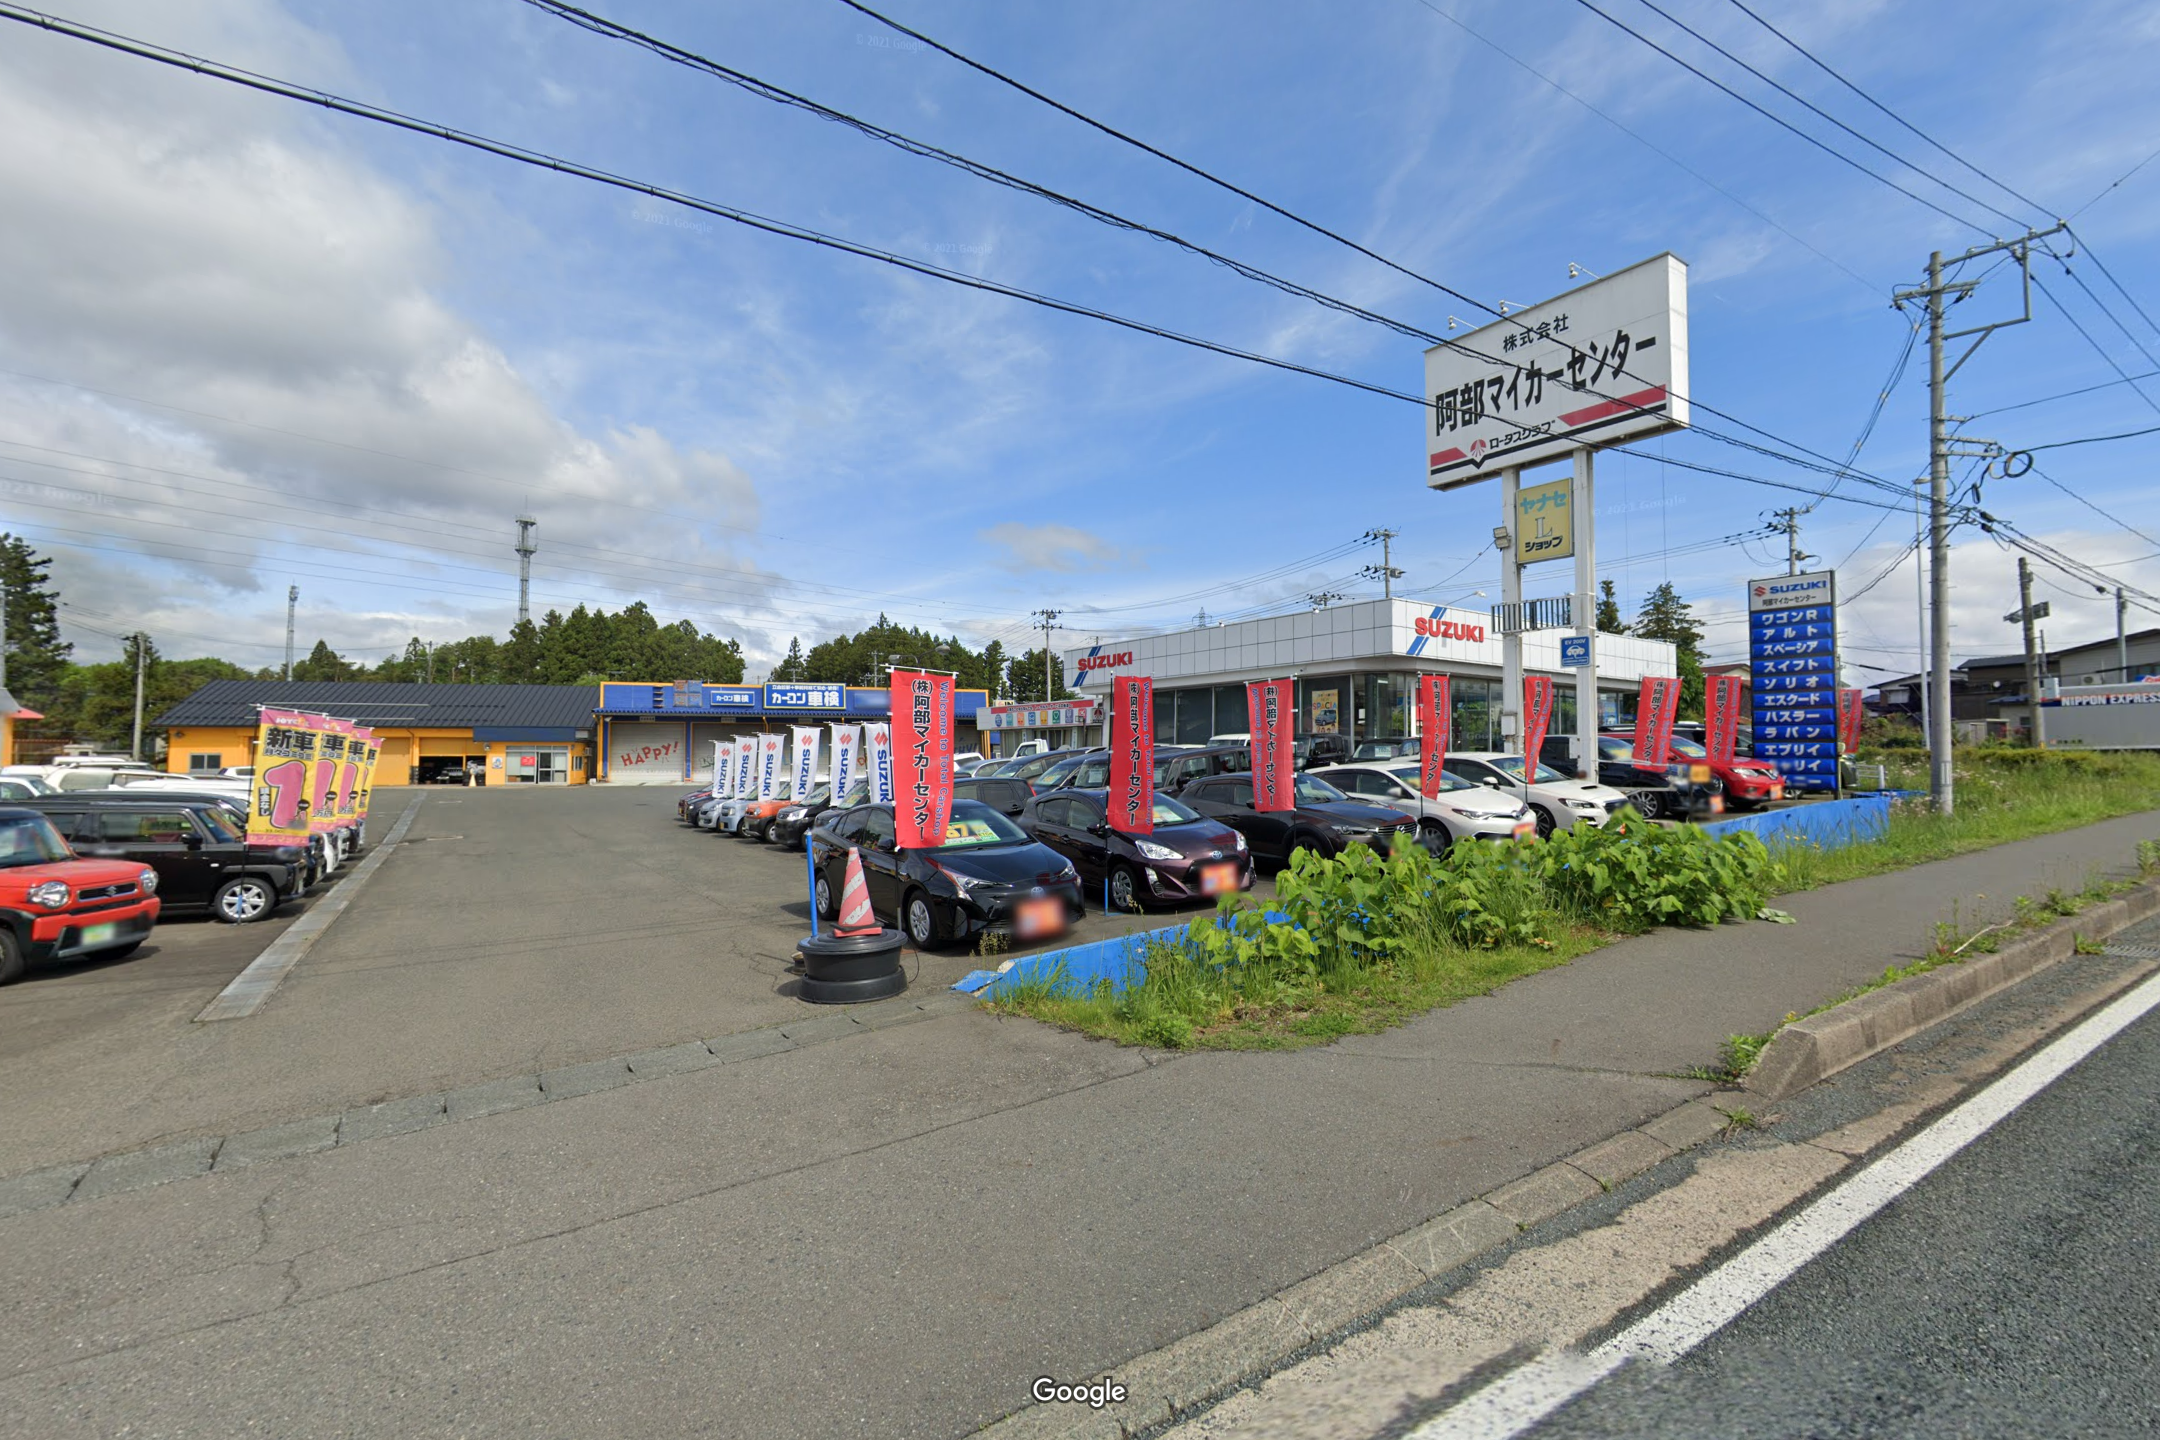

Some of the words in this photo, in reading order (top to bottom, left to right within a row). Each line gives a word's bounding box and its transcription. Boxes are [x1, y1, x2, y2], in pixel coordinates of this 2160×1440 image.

[1503, 314, 1569, 352] 株式会社
[1436, 330, 1656, 436] 阿部マイカーセンター
[1490, 420, 1555, 449] ロータスクラブ
[1520, 490, 1567, 514] ヤナセ
[1536, 517, 1552, 539] L
[1525, 536, 1563, 552] ショップ
[1770, 580, 1827, 594] SUZUKI
[1762, 610, 1818, 625] ワゴンR
[1415, 617, 1484, 642] SUZUKI
[1764, 625, 1818, 640] アルト
[1764, 641, 1818, 656] スペーシア
[1077, 651, 1133, 671] SUZUKI
[1764, 658, 1818, 673] スイフト
[1765, 676, 1819, 689] ソリオ
[940, 681, 949, 735] Welcome
[1312, 702, 1337, 710] SPACIA
[1765, 693, 1819, 706] エスクード
[2061, 695, 2106, 706] NIPPON
[1765, 711, 1819, 722] ハスラー
[266, 728, 316, 751] 新車
[940, 738, 948, 751] to
[1144, 734, 1149, 745] to
[1765, 744, 1821, 756] エブリイ
[621, 741, 679, 766] HAPPY!
[911, 679, 933, 841] (株)阿部マイカーセンター
[718, 758, 728, 794] SUZUKI
[739, 755, 749, 793] SUZUKI
[763, 754, 774, 796] SUZUKI
[798, 749, 810, 795] SUZUKI
[838, 748, 848, 798] SUZUKI
[878, 750, 889, 803] SUZUK
[940, 754, 949, 784] Total
[933, 789, 948, 836] Carshop
